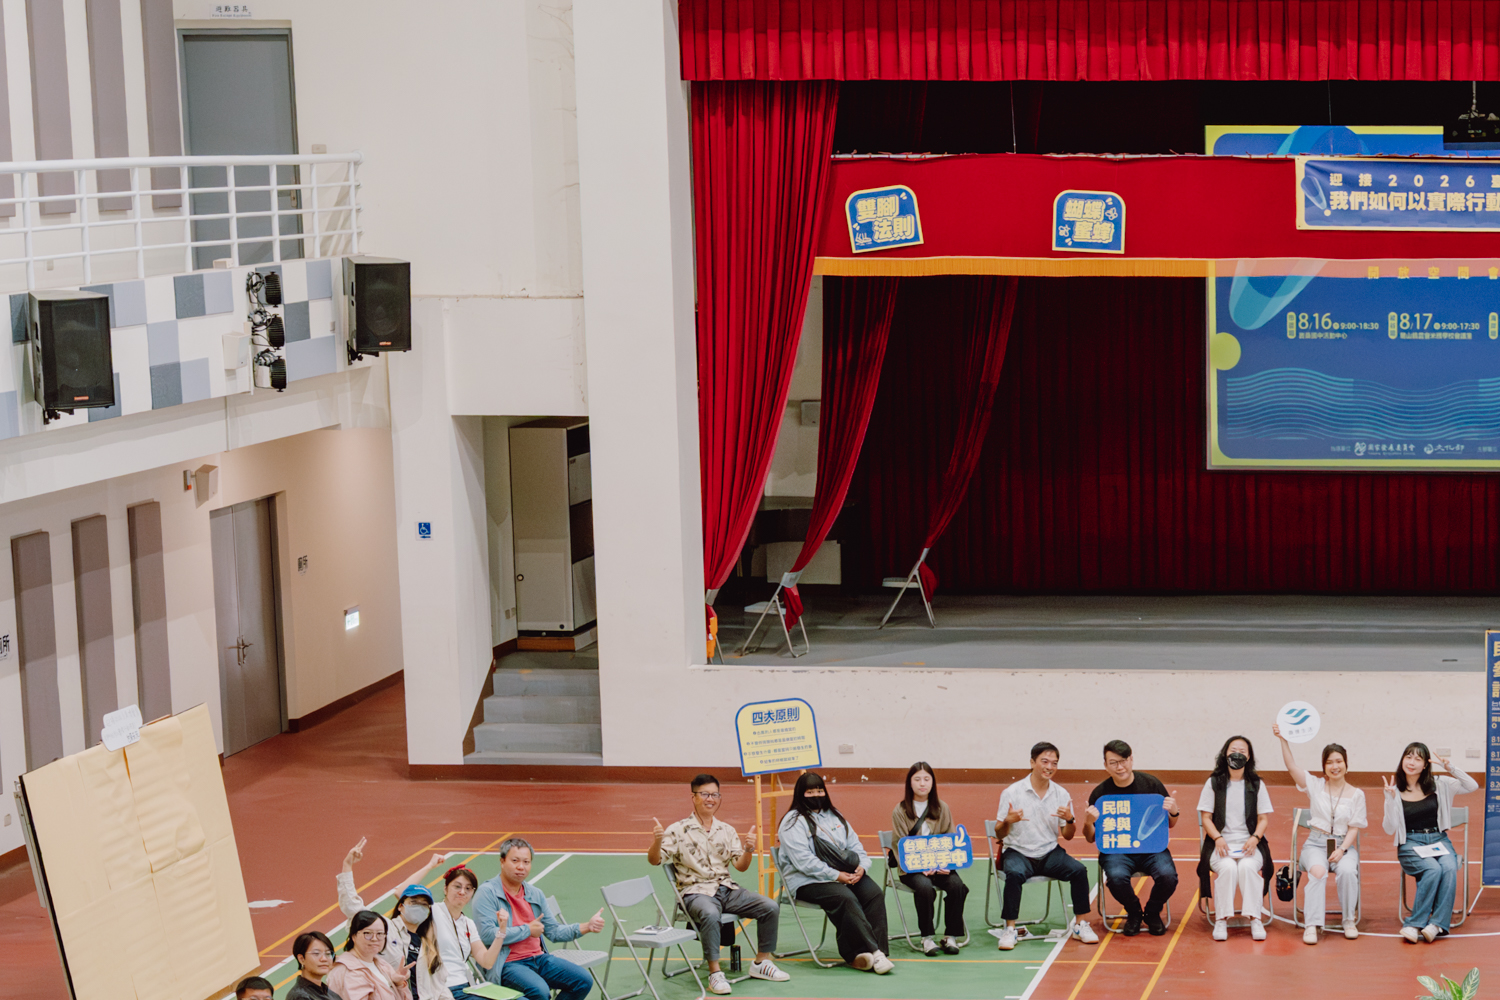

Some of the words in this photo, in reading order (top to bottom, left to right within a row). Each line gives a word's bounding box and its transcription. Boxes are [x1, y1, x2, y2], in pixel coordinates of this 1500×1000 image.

[855, 194, 900, 221] 雙腳
[1063, 199, 1106, 222] 蝴蝶
[873, 214, 915, 242] 法則
[1073, 221, 1115, 244] 蜜蜂
[1298, 312, 1332, 330] 8/16
[1340, 322, 1380, 330] 9:00-18:30
[1399, 312, 1433, 330] 8/17
[1441, 322, 1480, 330] 9:00-17:30
[1434, 443, 1465, 452] 文化部
[752, 706, 800, 726] 四大原則
[1102, 800, 1131, 816] 民間
[1102, 817, 1131, 832] 參與
[1102, 833, 1132, 849] 計畫
[904, 849, 968, 871] 在我手中
